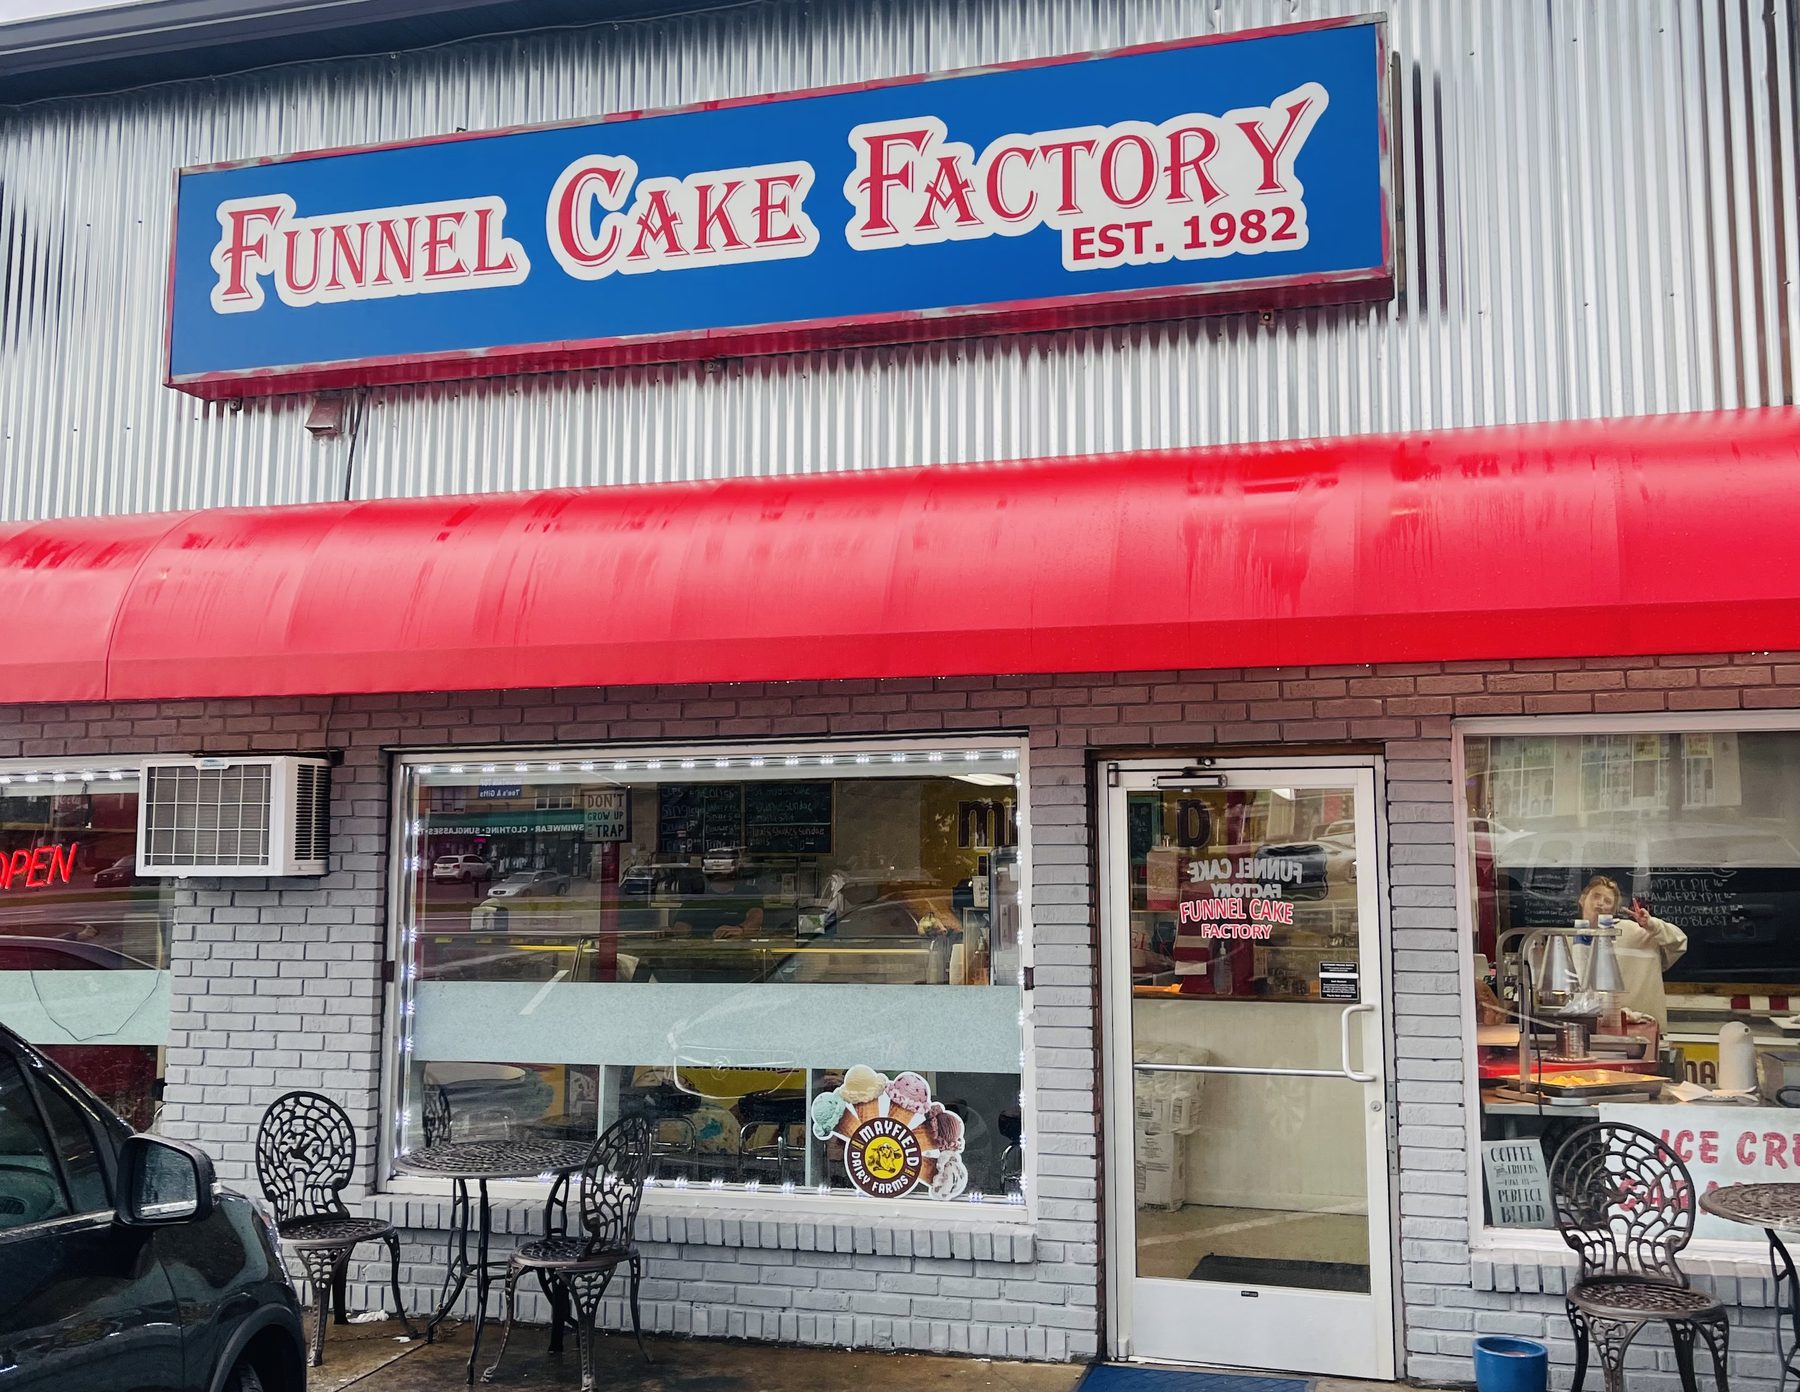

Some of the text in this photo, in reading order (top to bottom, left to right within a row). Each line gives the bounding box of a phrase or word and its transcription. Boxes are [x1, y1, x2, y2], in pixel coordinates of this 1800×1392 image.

[219, 94, 1316, 303] FUNNEL CAKE FACTORY
[1071, 206, 1298, 261] EST. 1982
[587, 793, 625, 809] DON'T
[587, 810, 625, 821] GROW UP
[595, 824, 625, 838] TRAP
[1180, 898, 1294, 925] FUNNEL CAKE
[1201, 923, 1273, 940] FACTORY
[859, 1120, 919, 1166] MAYFIELD
[851, 1151, 909, 1193] DAIRY FARMS
